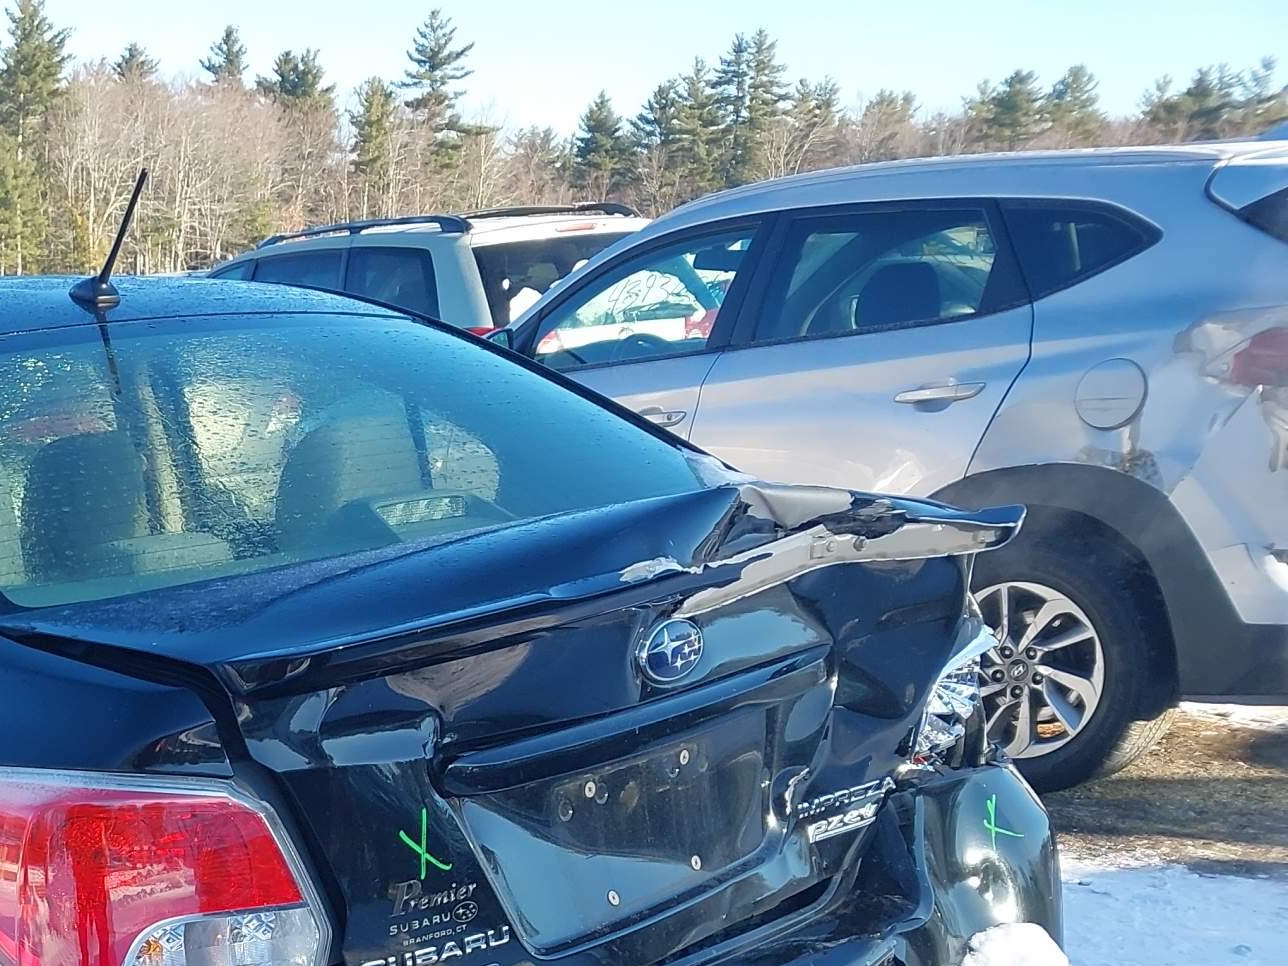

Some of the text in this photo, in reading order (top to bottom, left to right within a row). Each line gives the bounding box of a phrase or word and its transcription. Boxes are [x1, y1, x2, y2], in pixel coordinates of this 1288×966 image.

[797, 776, 897, 819] IMPREZA
[389, 879, 478, 918] Premier
[389, 912, 452, 936] SUBARU
